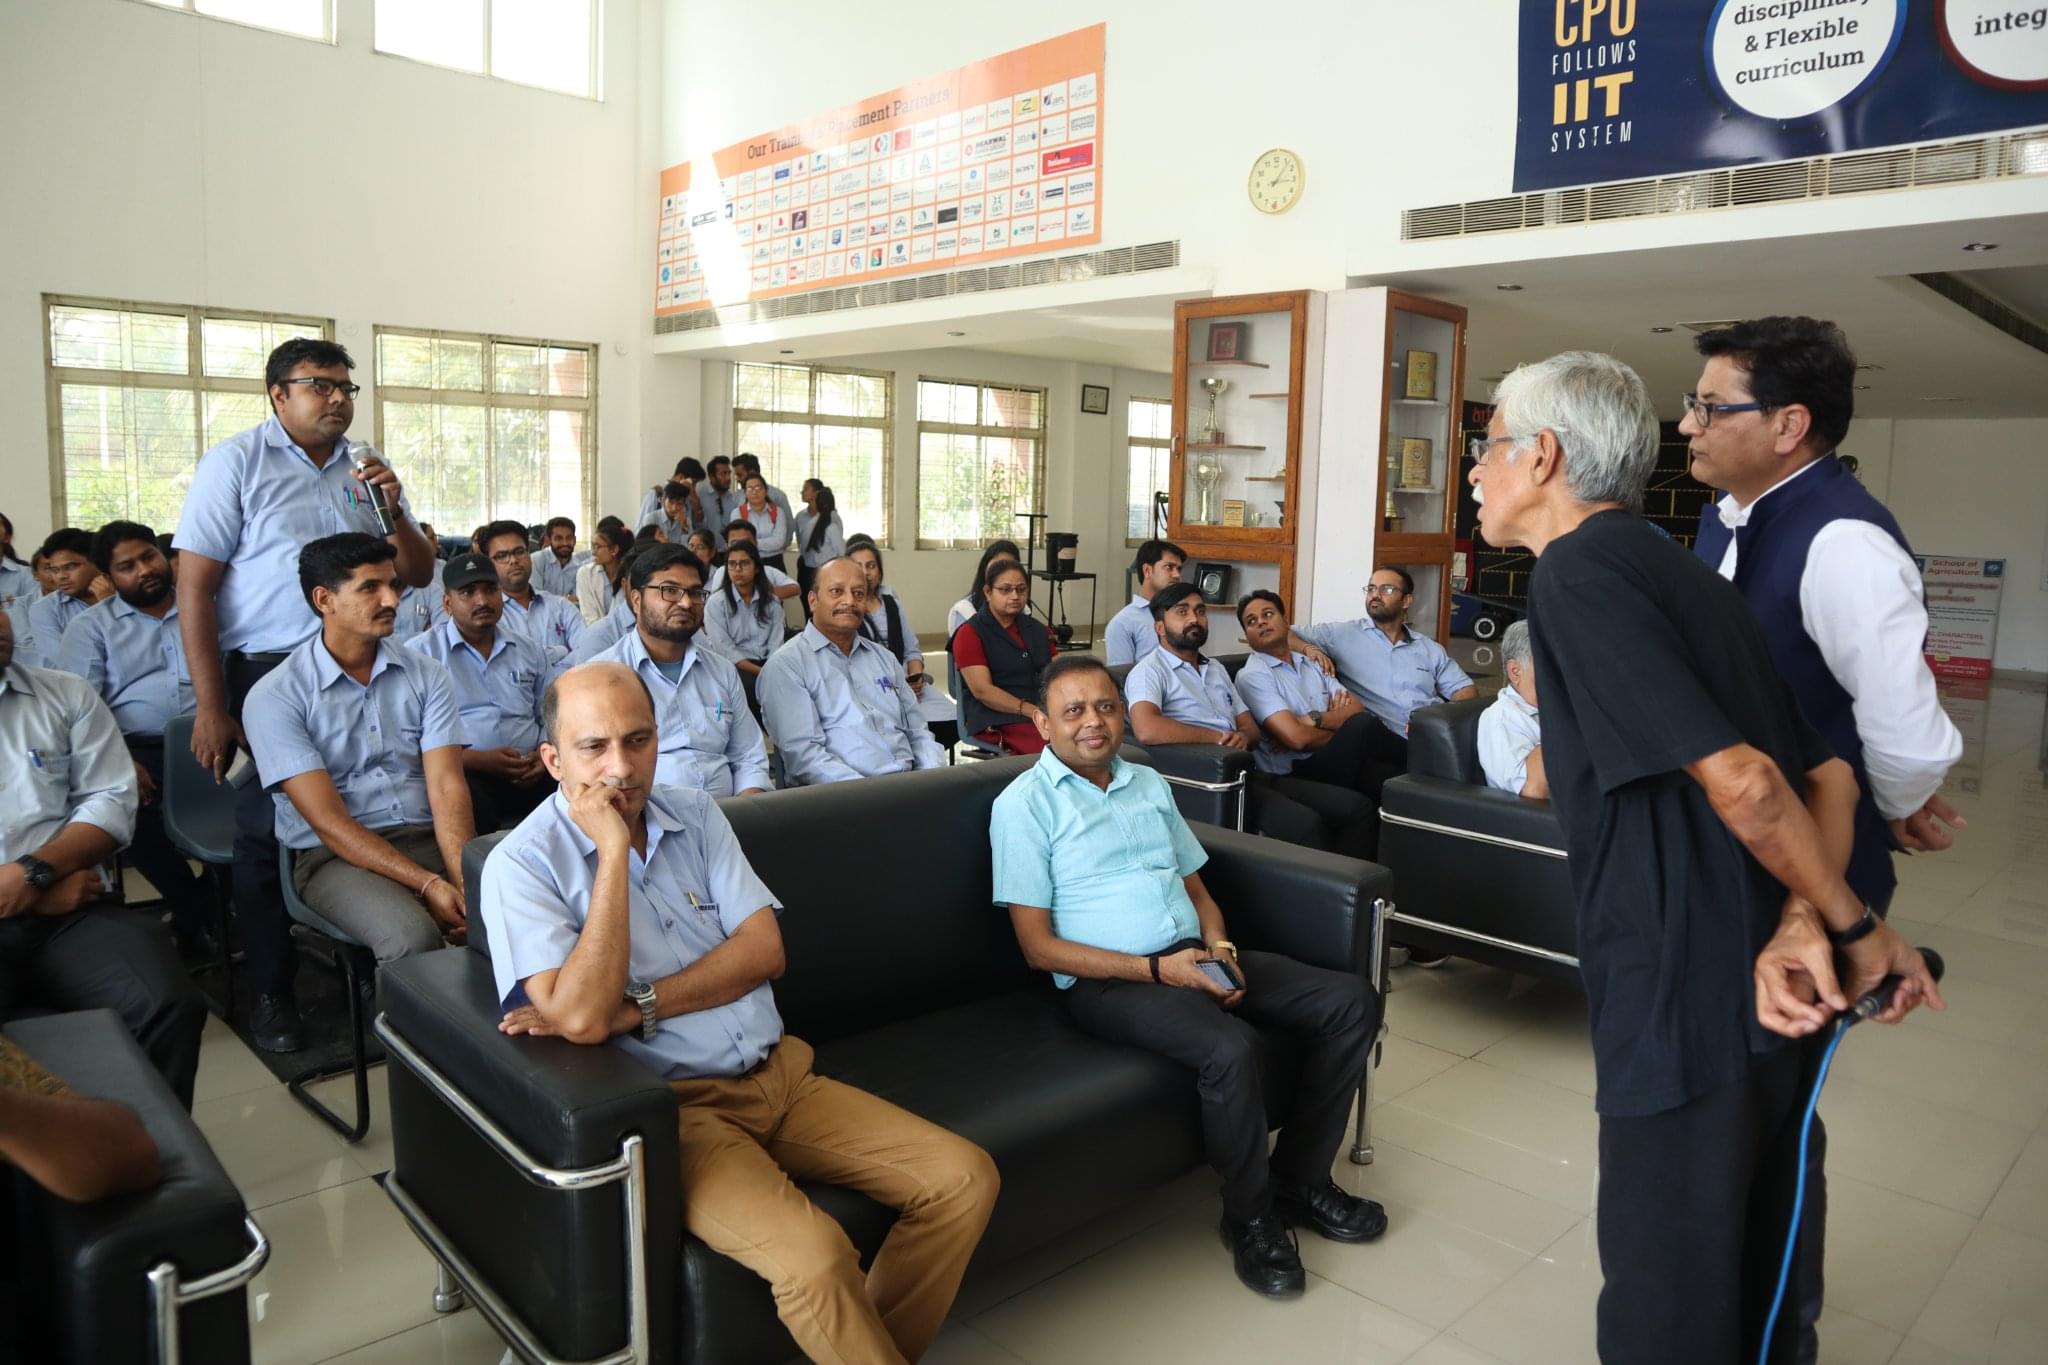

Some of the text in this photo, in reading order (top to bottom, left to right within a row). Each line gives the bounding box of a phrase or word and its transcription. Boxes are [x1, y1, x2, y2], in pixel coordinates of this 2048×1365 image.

[1744, 18, 1859, 53] & Flexible
[1974, 8, 2048, 36] integ
[1552, 39, 1637, 75] FOLLOWS
[1735, 48, 1865, 85] curriculum
[1553, 70, 1635, 125] IIT
[747, 141, 767, 160] Our
[1551, 120, 1632, 154] SYSTEM
[1927, 567, 1979, 576] Agriculture
